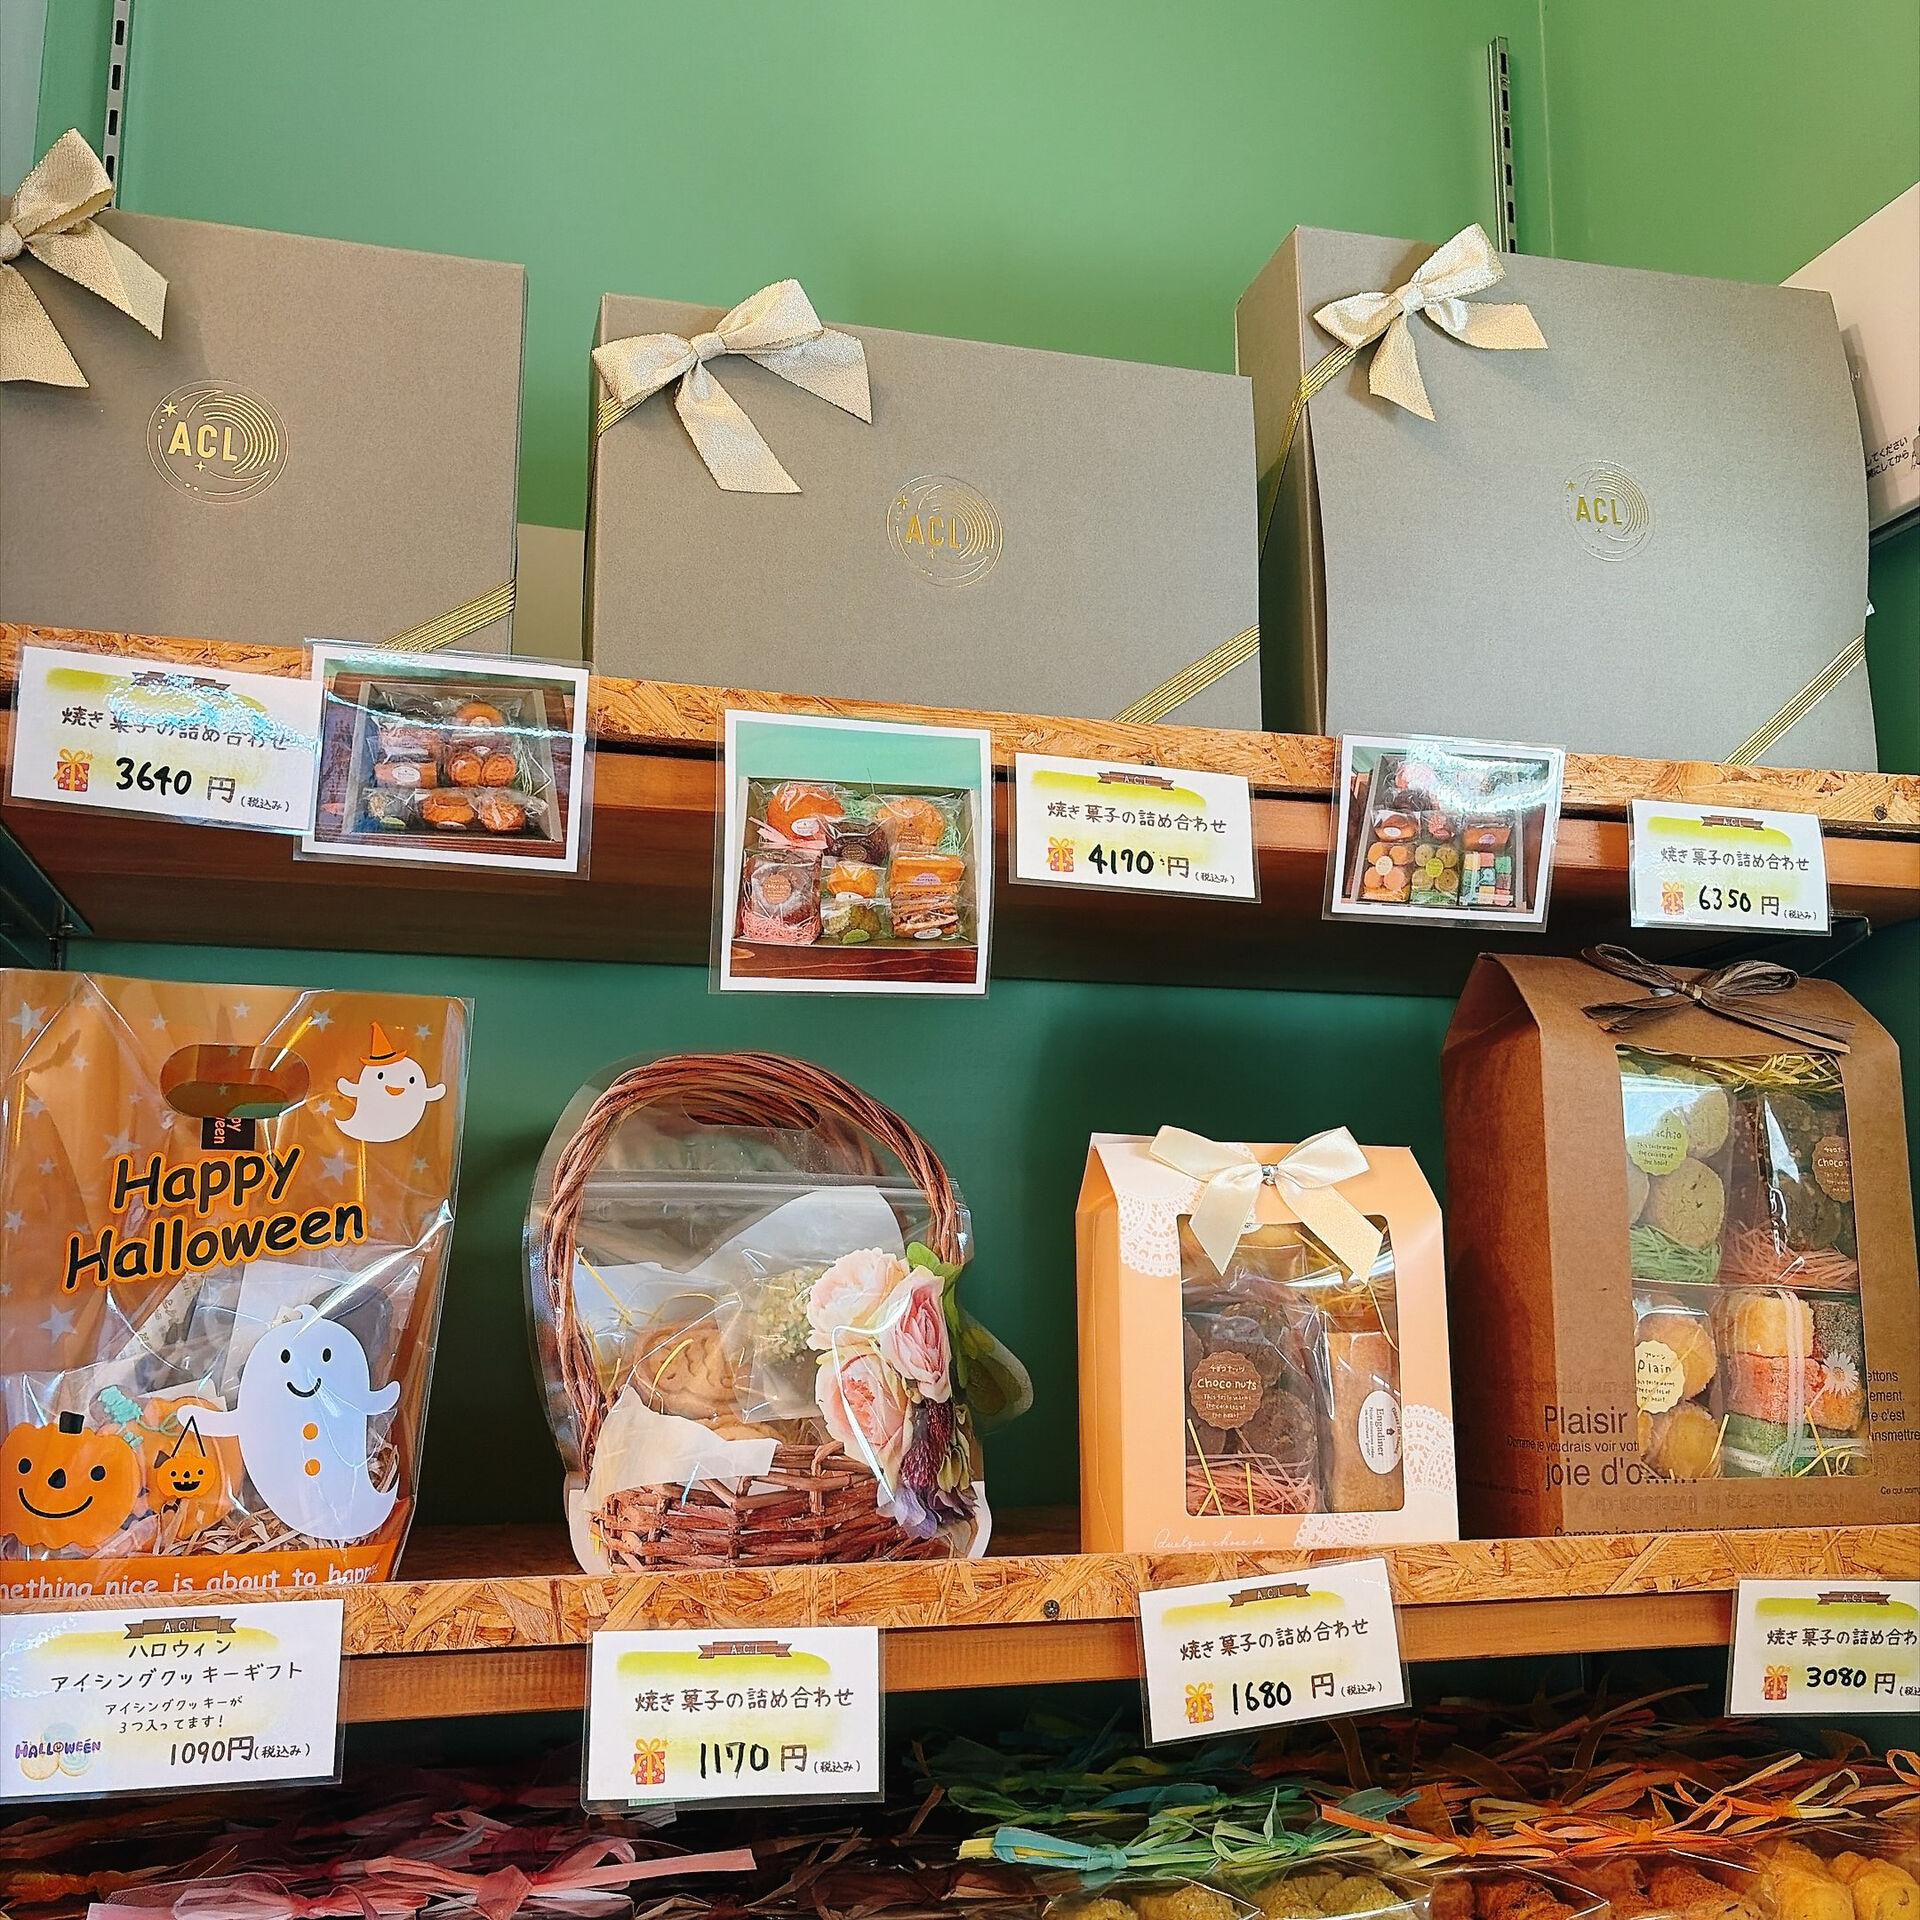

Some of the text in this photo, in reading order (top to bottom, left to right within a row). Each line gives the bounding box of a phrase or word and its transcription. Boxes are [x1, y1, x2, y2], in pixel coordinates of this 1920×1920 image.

[167, 421, 238, 462] ACL
[1575, 493, 1623, 526] ACL
[905, 513, 962, 549] ACL
[115, 756, 192, 796] 3640
[206, 775, 236, 803] 円
[1047, 800, 1227, 834] 焼き菓子の詰め合わせ
[1088, 843, 1154, 875] 4170
[1167, 856, 1189, 879] 円
[1660, 845, 1809, 871] 焼き菓子の詰め合わせ
[1699, 885, 1751, 913] 6350
[1761, 895, 1780, 917] 円
[110, 1146, 302, 1215] Happy
[63, 1202, 365, 1292] Halloween
[1637, 1359, 1672, 1374] Plain
[1197, 1377, 1257, 1391] Choco nuts
[1543, 1404, 1629, 1435] Plaisir
[1881, 1408, 1906, 1422] c'est
[1545, 1440, 1592, 1453] voudrais
[1594, 1440, 1617, 1453] voir
[1545, 1456, 1591, 1492] joie
[105, 1575, 158, 1597] nice
[173, 1572, 193, 1594] is
[205, 1568, 280, 1591] about
[291, 1567, 316, 1587] to
[128, 1639, 232, 1659] ハロウィン
[1179, 1618, 1369, 1661] 焼き菓子の詰め合わせ
[1766, 1627, 1918, 1647] 焼き菓子の詰め合わ
[50, 1660, 303, 1693] アイシングクッキーギフト
[1806, 1666, 1867, 1688] 3080
[1874, 1673, 1896, 1694] 円
[104, 1694, 243, 1716] アイシングクッキーが
[634, 1686, 855, 1713] 焼き菓子の詰め合わせ
[1232, 1680, 1292, 1715] 1680
[1311, 1672, 1335, 1699] 円
[700, 1741, 769, 1779] 1170
[780, 1743, 808, 1772] 円
